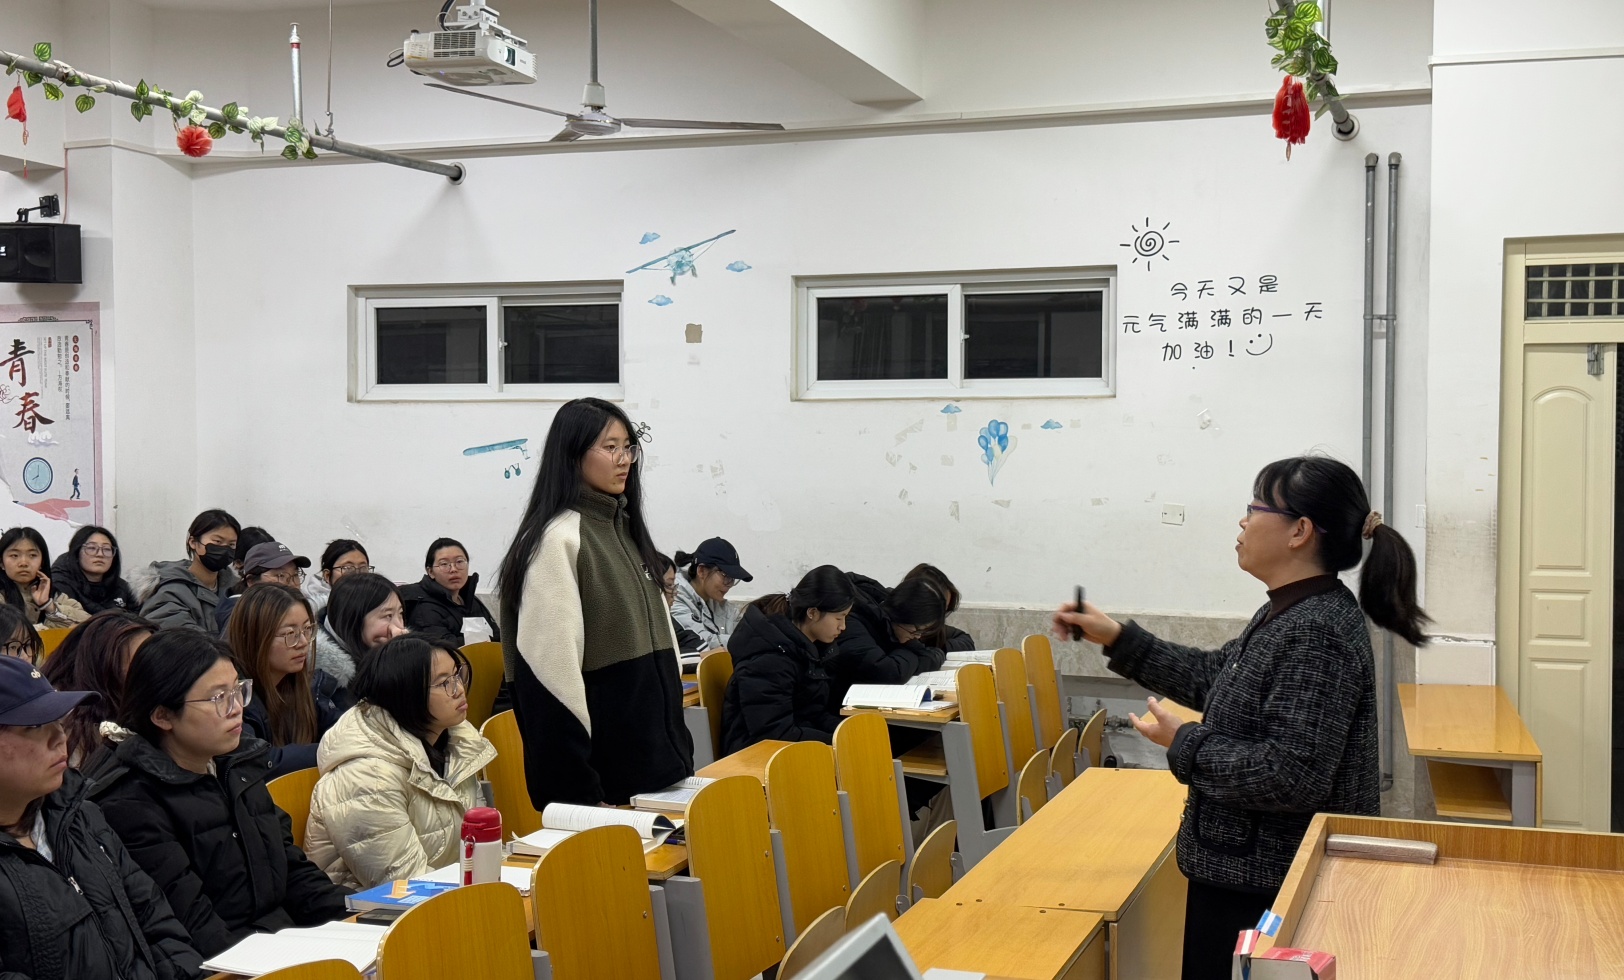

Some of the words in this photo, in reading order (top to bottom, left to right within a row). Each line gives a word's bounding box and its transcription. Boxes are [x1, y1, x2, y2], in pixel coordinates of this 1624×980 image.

[1171, 275, 1278, 301] 今天又是
[1123, 302, 1323, 333] 元气满满的一天
[1162, 340, 1235, 361] 加油!
[0, 339, 55, 434] 青春
